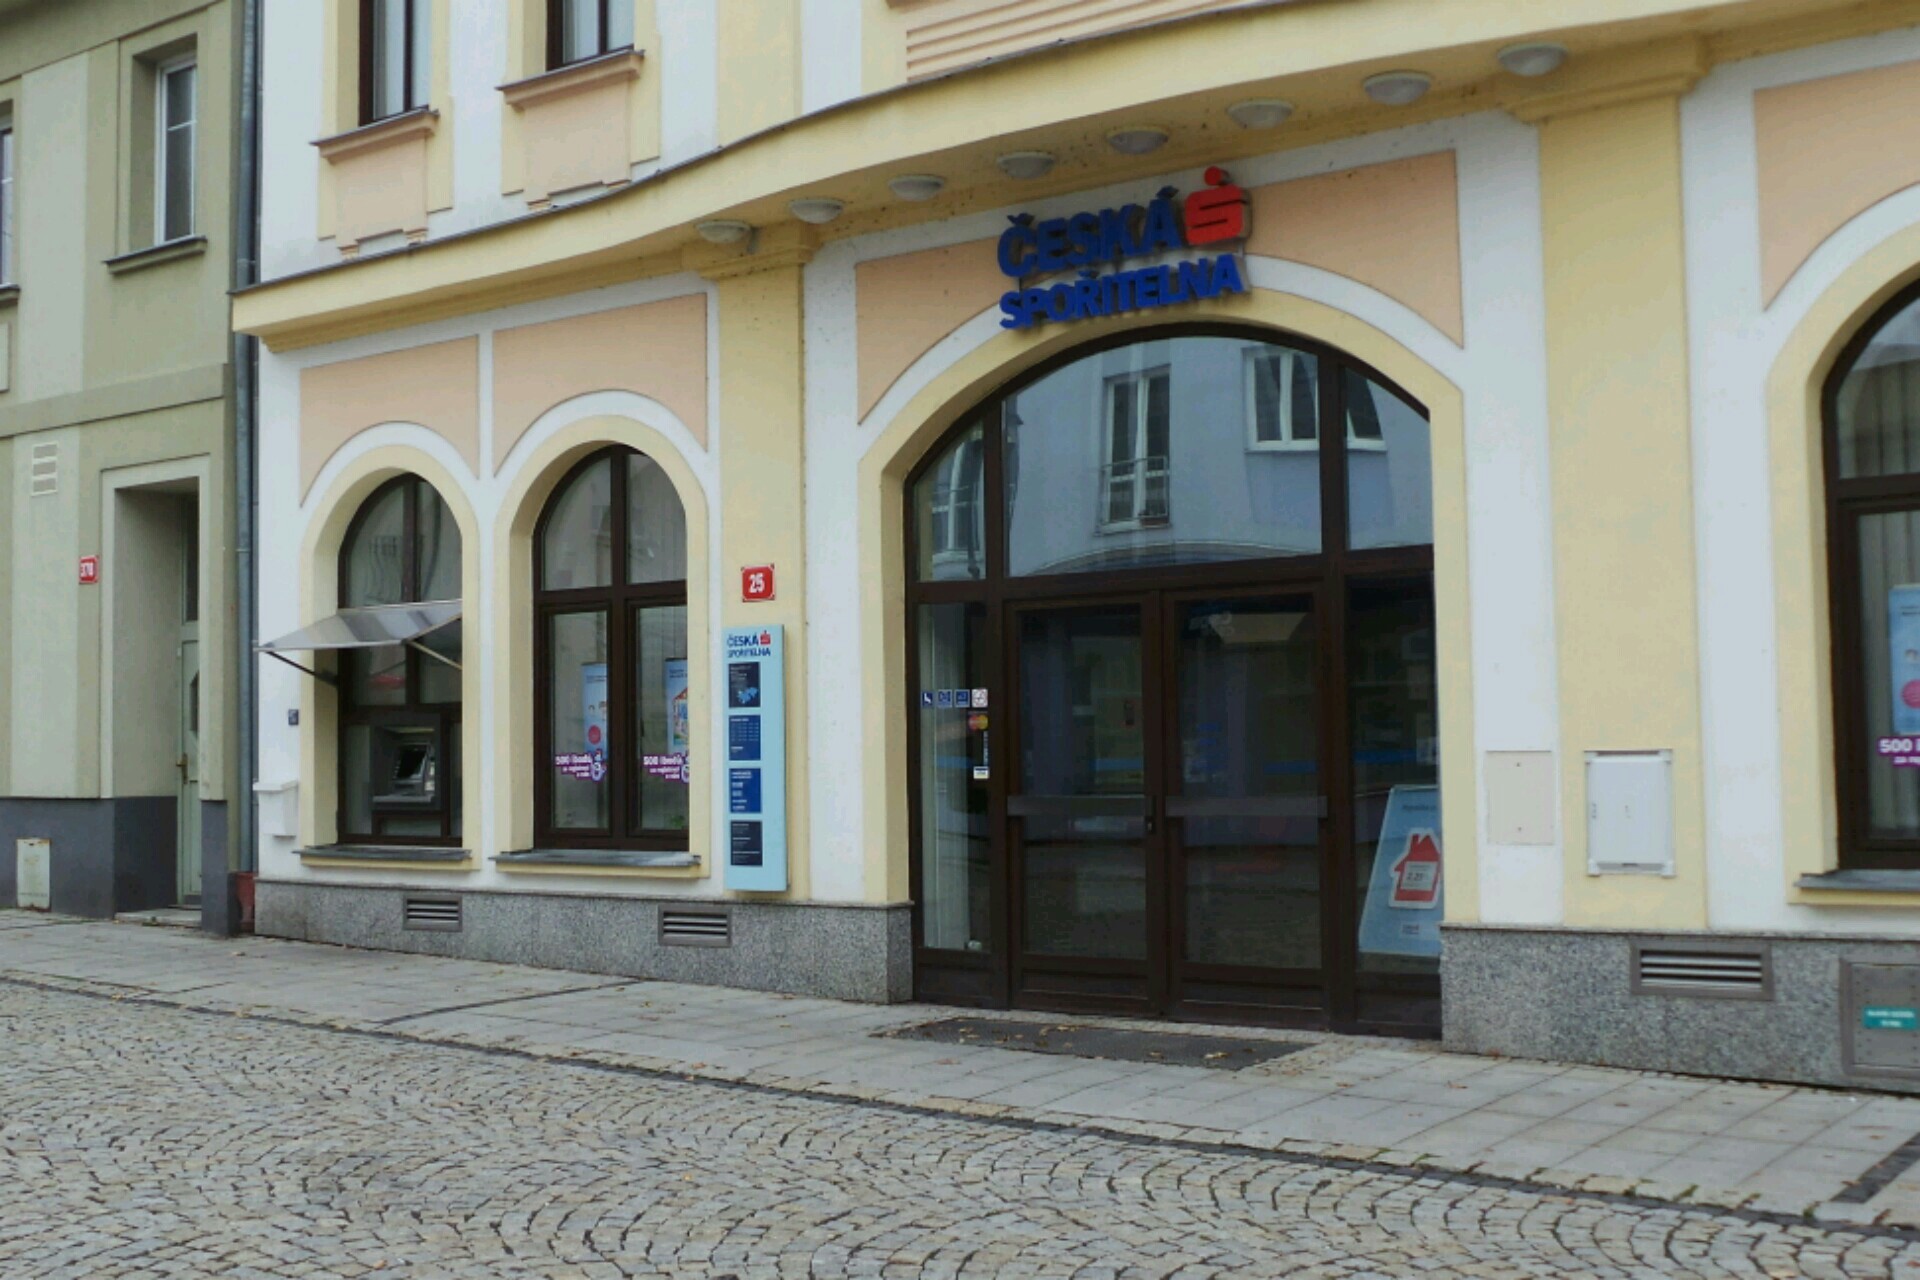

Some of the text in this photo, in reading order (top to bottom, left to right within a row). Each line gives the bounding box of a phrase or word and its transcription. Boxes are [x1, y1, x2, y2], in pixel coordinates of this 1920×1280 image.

[997, 185, 1183, 277] ČESKÁ
[999, 253, 1245, 329] SPOŘITELNA
[748, 572, 765, 594] 25
[1879, 738, 1913, 753] 500
